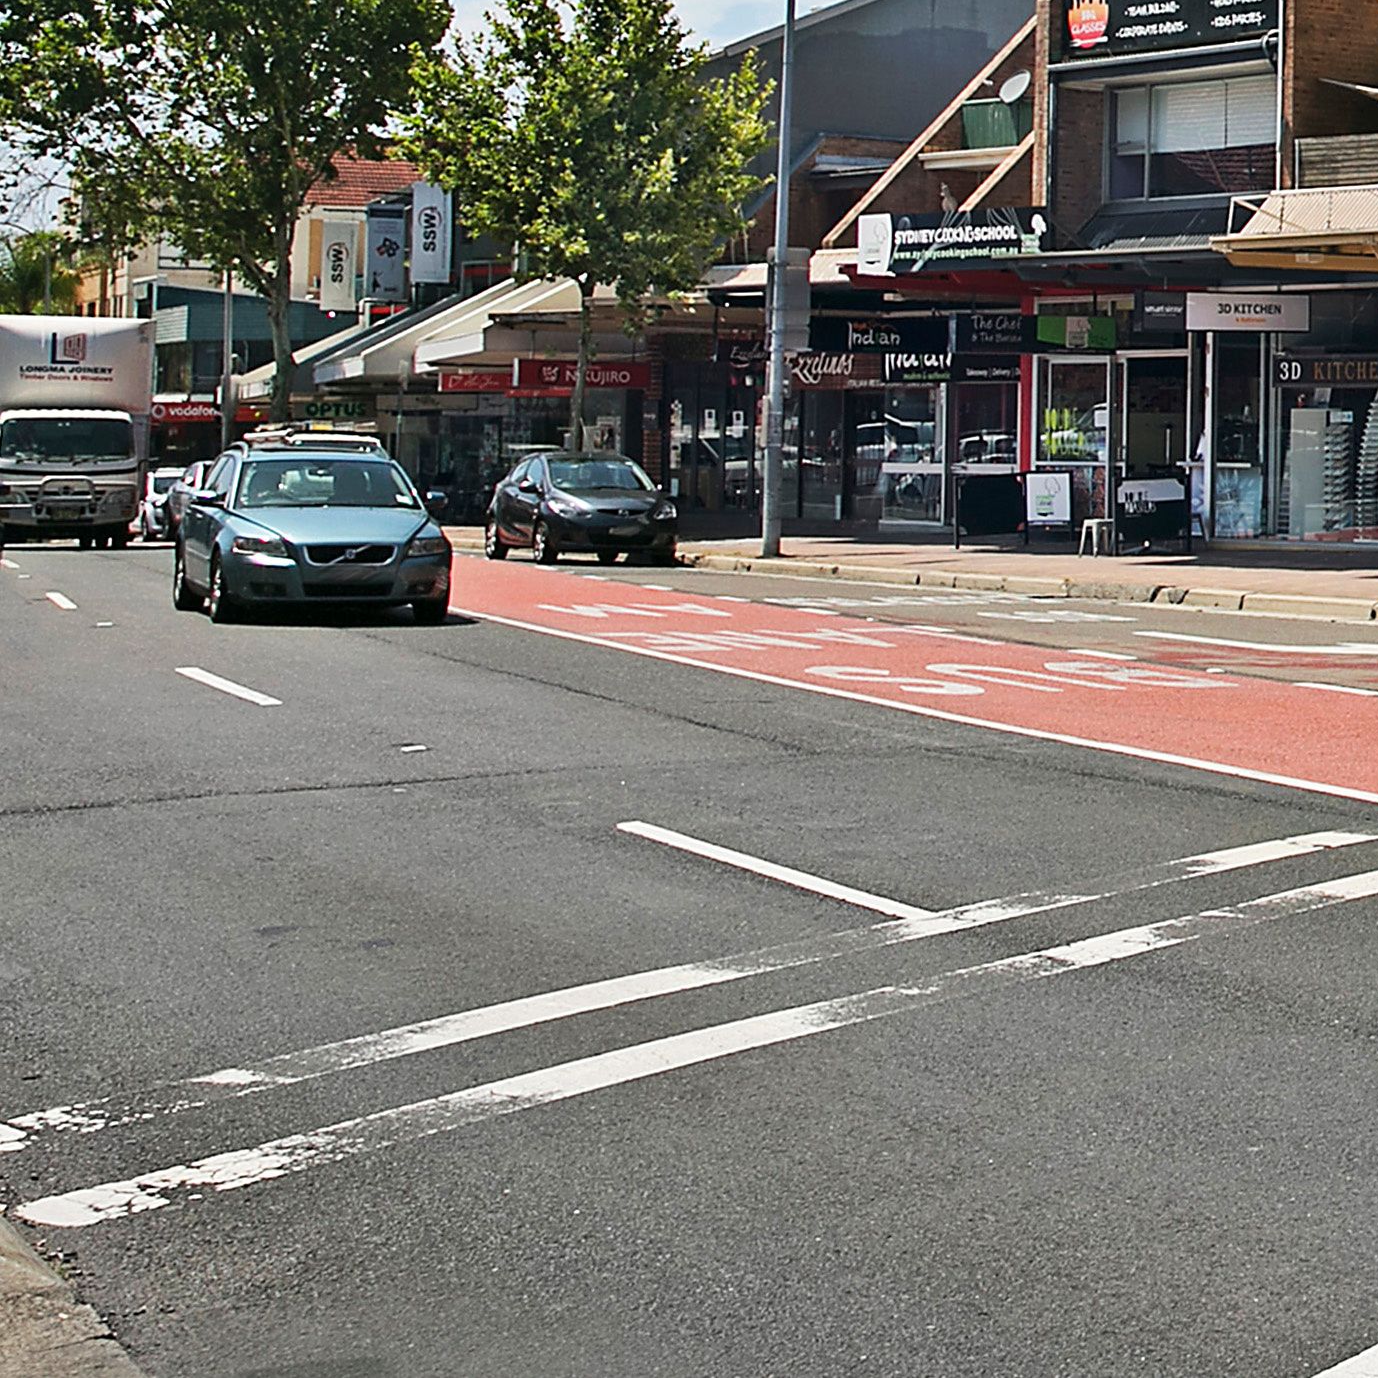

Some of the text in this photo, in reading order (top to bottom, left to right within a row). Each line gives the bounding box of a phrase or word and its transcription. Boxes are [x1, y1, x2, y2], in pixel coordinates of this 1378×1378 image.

[423, 213, 437, 253] SSW
[894, 228, 936, 244] SYDNEY
[974, 225, 1018, 240] SCHOOL
[331, 248, 344, 283] SSW
[1218, 303, 1282, 314] 3D KITCHEN
[971, 315, 1022, 330] The Chef
[848, 322, 901, 350] Indian
[19, 366, 113, 374] LONGMA JOINERY
[565, 370, 630, 385] NKUJIRO
[1279, 362, 1302, 380] 3D
[305, 402, 367, 418] OPTUS
[803, 660, 1240, 696] BUS
